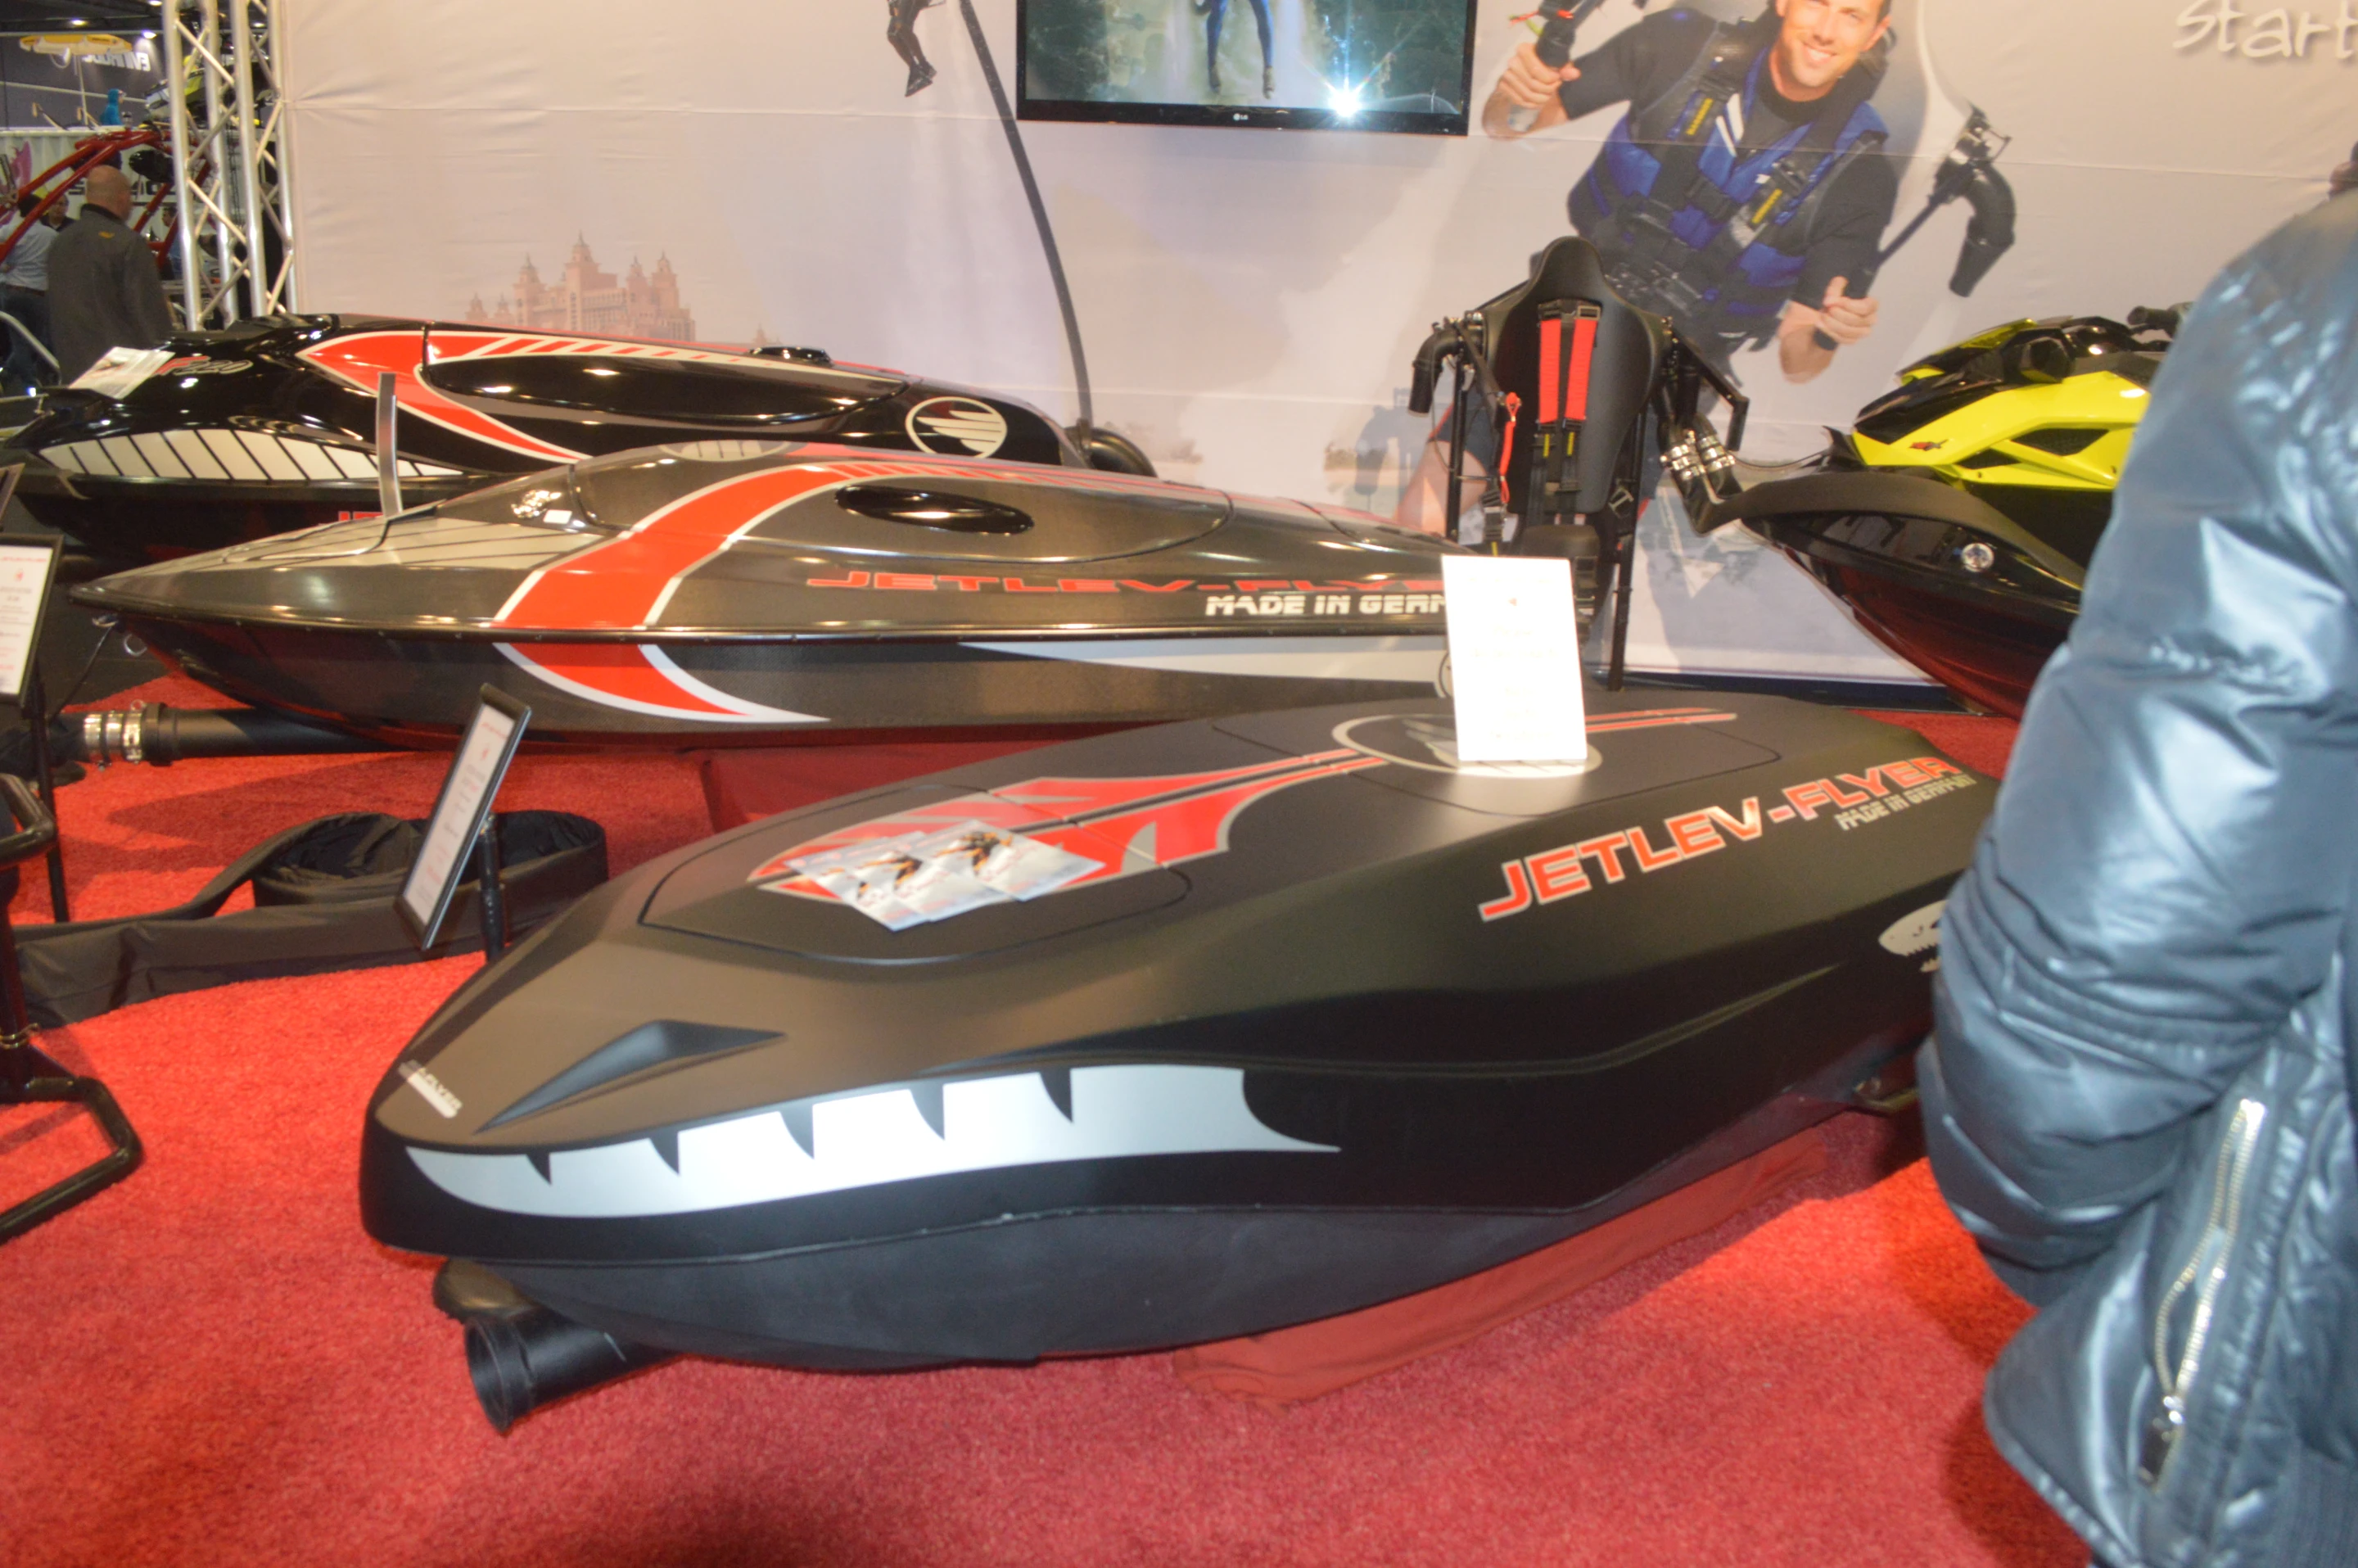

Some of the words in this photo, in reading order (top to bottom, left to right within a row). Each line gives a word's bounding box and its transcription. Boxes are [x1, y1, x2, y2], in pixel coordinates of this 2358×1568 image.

[1205, 594, 1307, 616] MADE
[1314, 594, 1351, 615] IN
[1834, 800, 1890, 831] MADE
[1883, 793, 1911, 812] IN
[1479, 757, 1963, 922] JETLEV-FLYER
